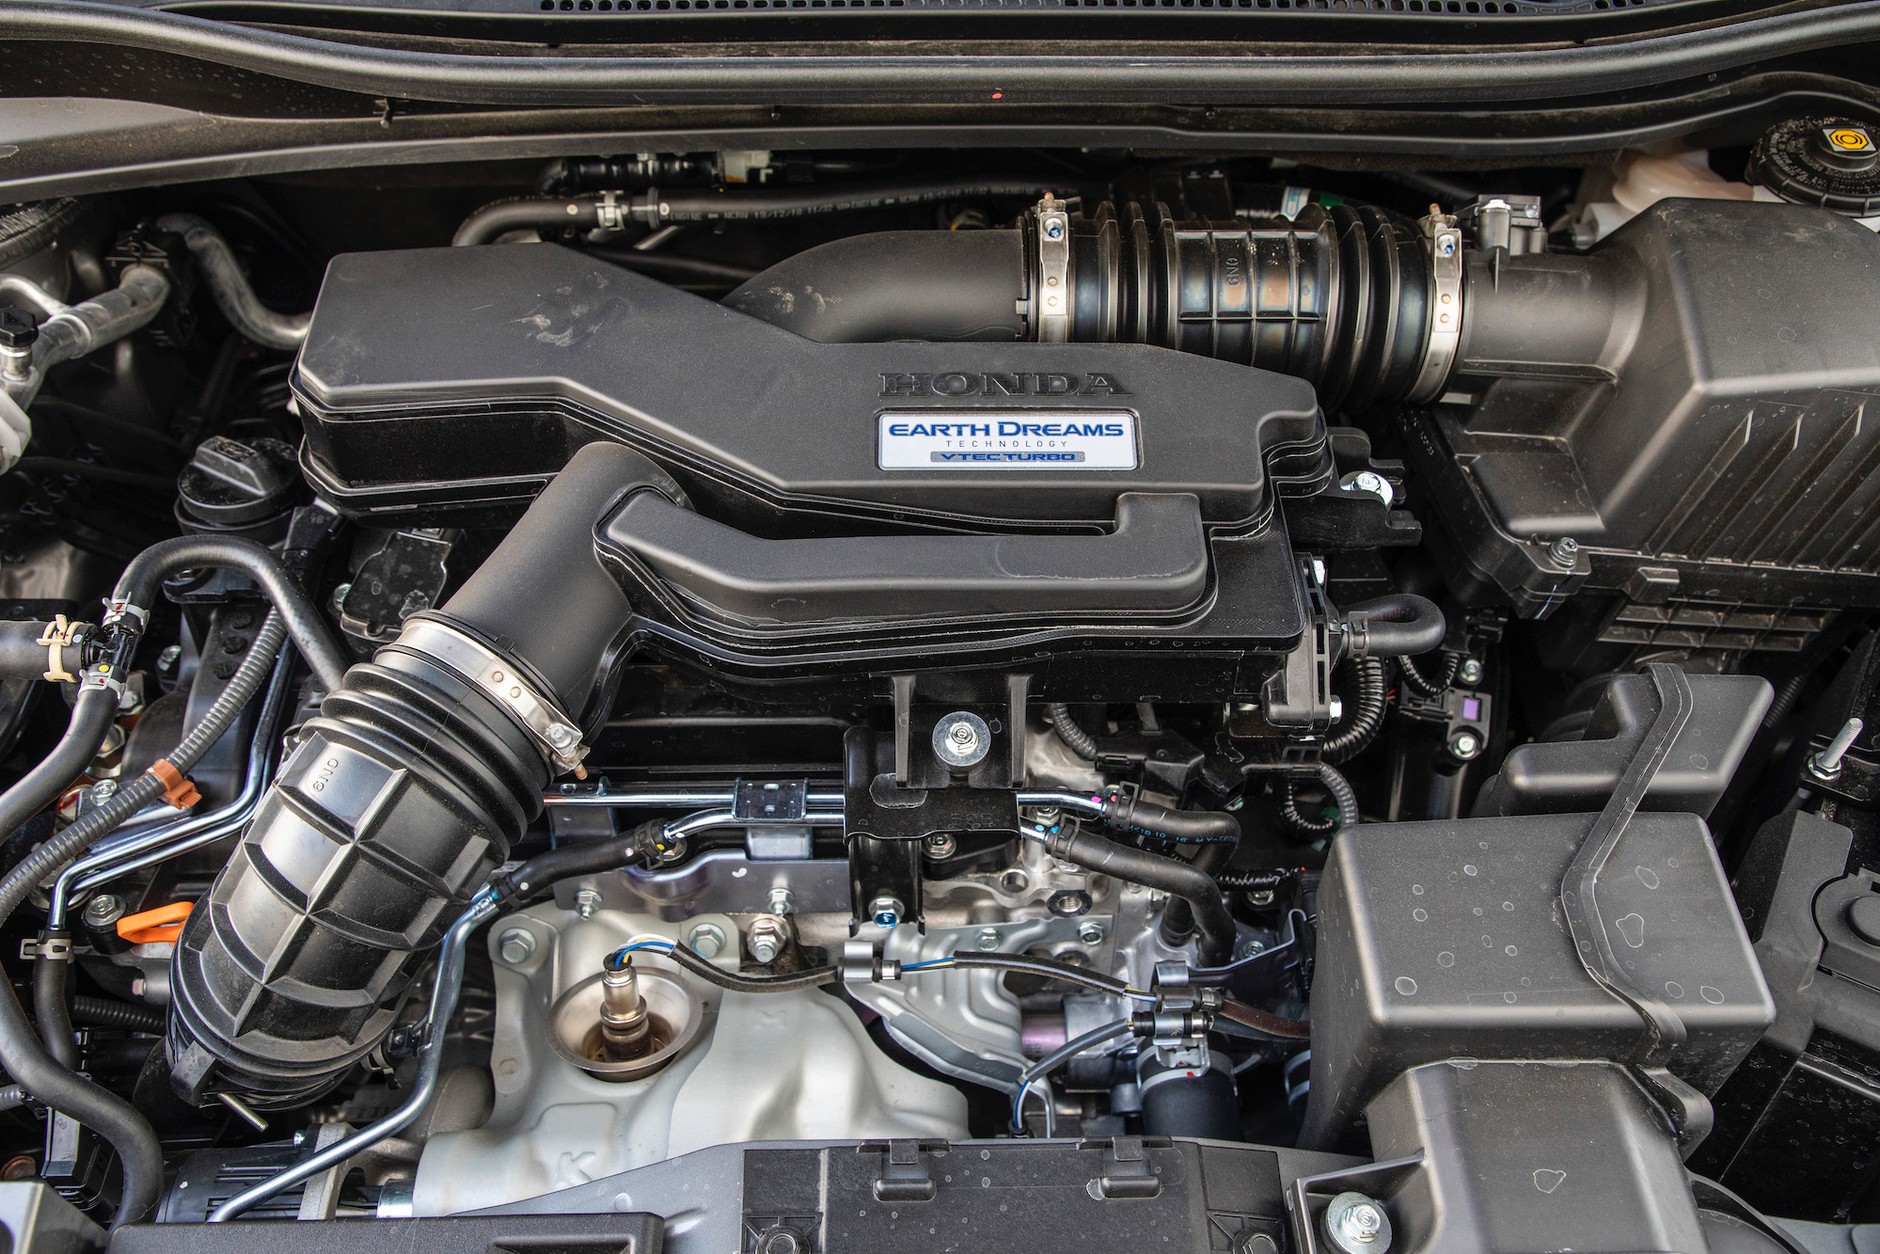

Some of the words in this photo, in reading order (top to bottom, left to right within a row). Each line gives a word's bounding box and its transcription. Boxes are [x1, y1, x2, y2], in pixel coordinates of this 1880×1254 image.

[877, 372, 1133, 397] HONDA
[888, 423, 990, 437] EARTH
[997, 421, 1125, 437] DREAMS
[946, 440, 1068, 448] TECHNOLOGY
